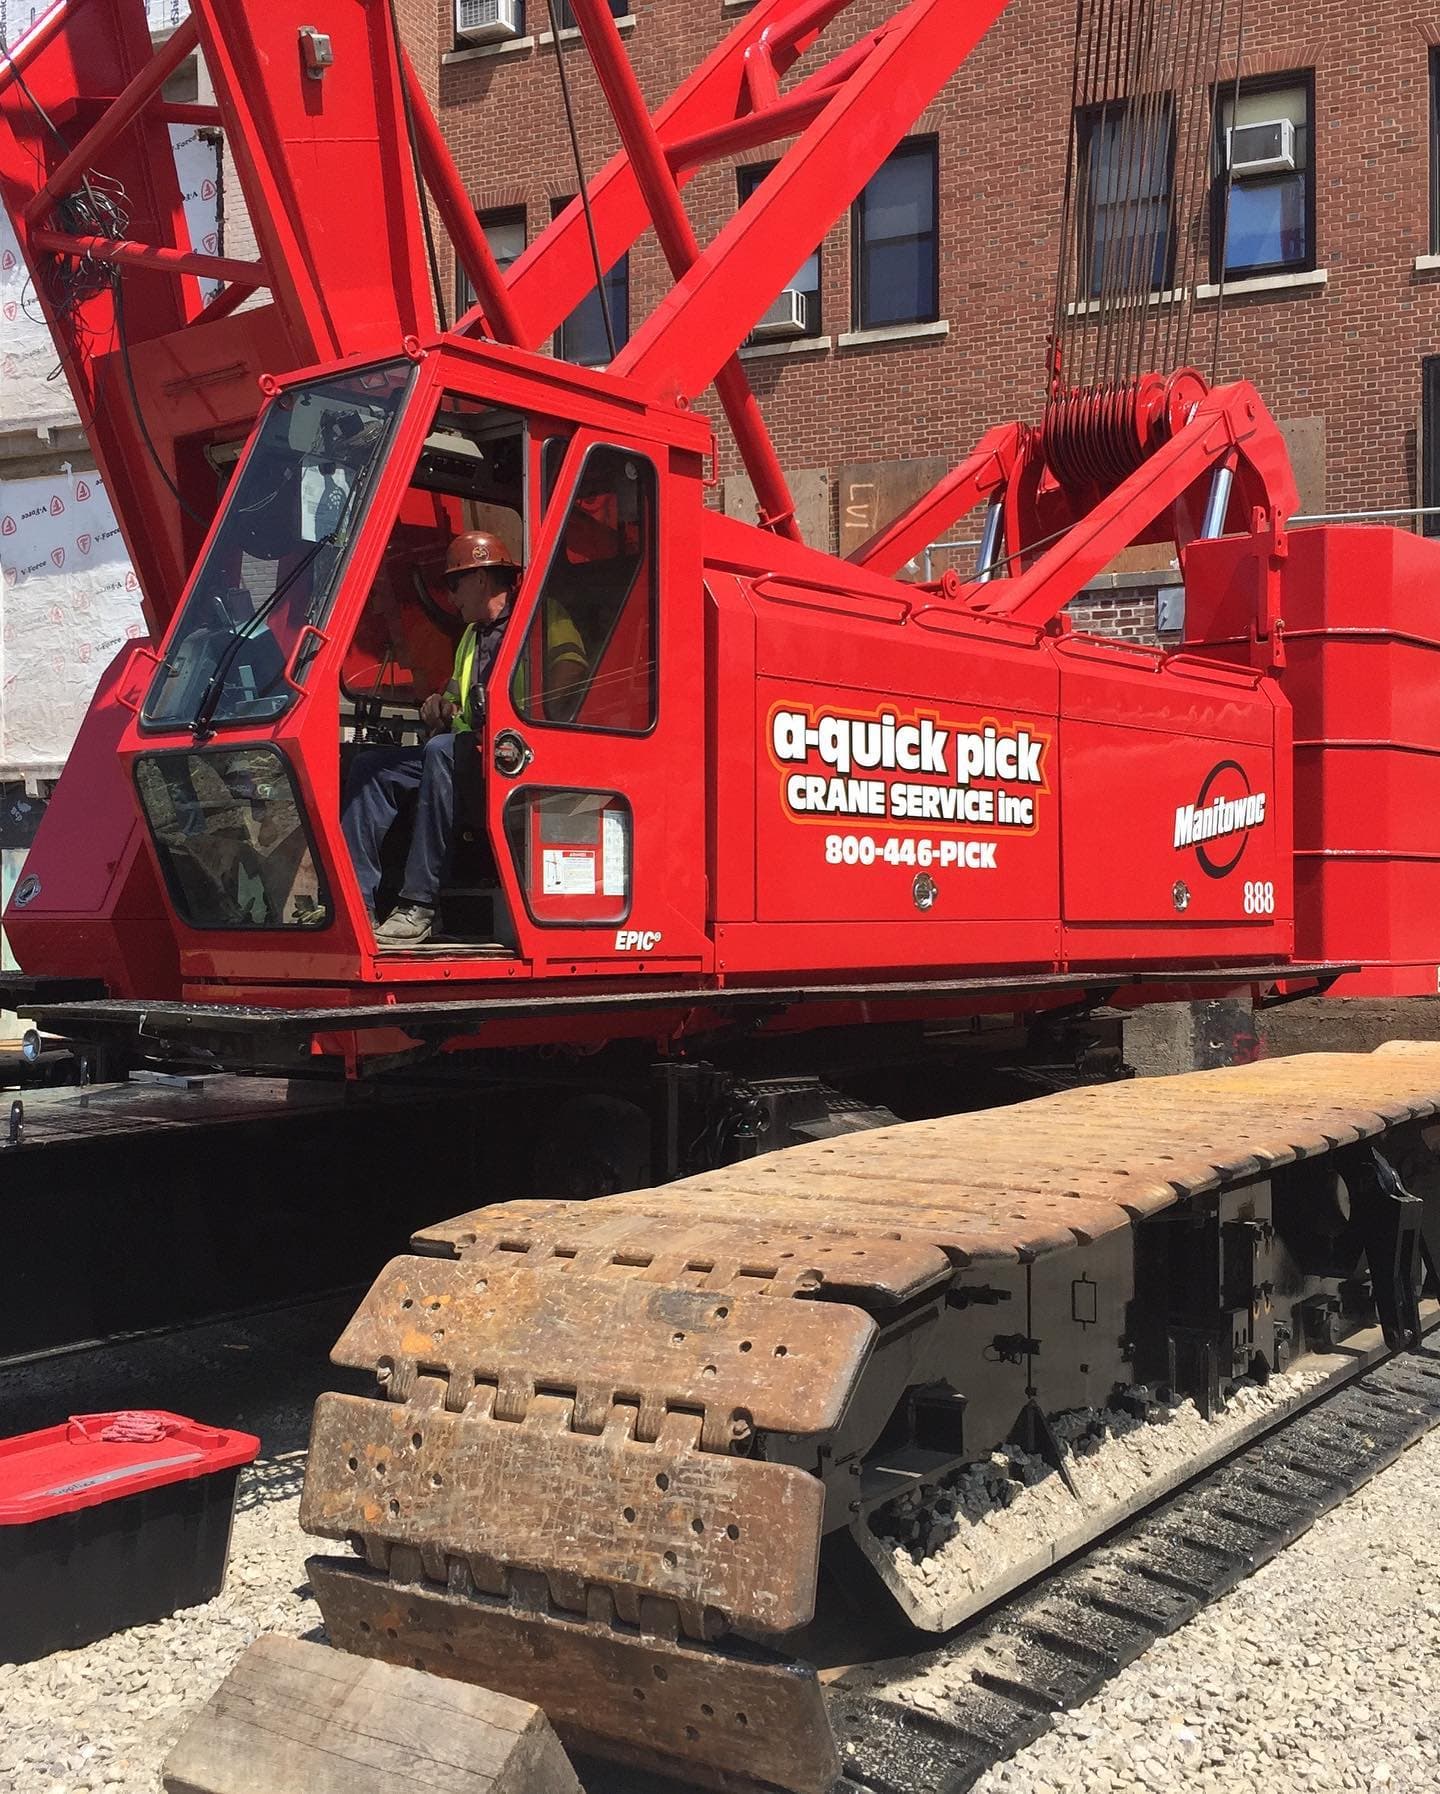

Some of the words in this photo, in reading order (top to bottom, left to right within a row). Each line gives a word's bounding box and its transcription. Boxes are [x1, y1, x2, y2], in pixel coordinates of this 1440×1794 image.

[773, 711, 948, 773] a-quick
[956, 727, 1043, 784] pick
[787, 775, 887, 815] CRANE
[890, 783, 994, 823] SERVICE
[998, 791, 1033, 825] inc
[1173, 793, 1266, 849] Manitowoc
[825, 835, 997, 868] 800-446-PICK
[1243, 881, 1275, 914] 888
